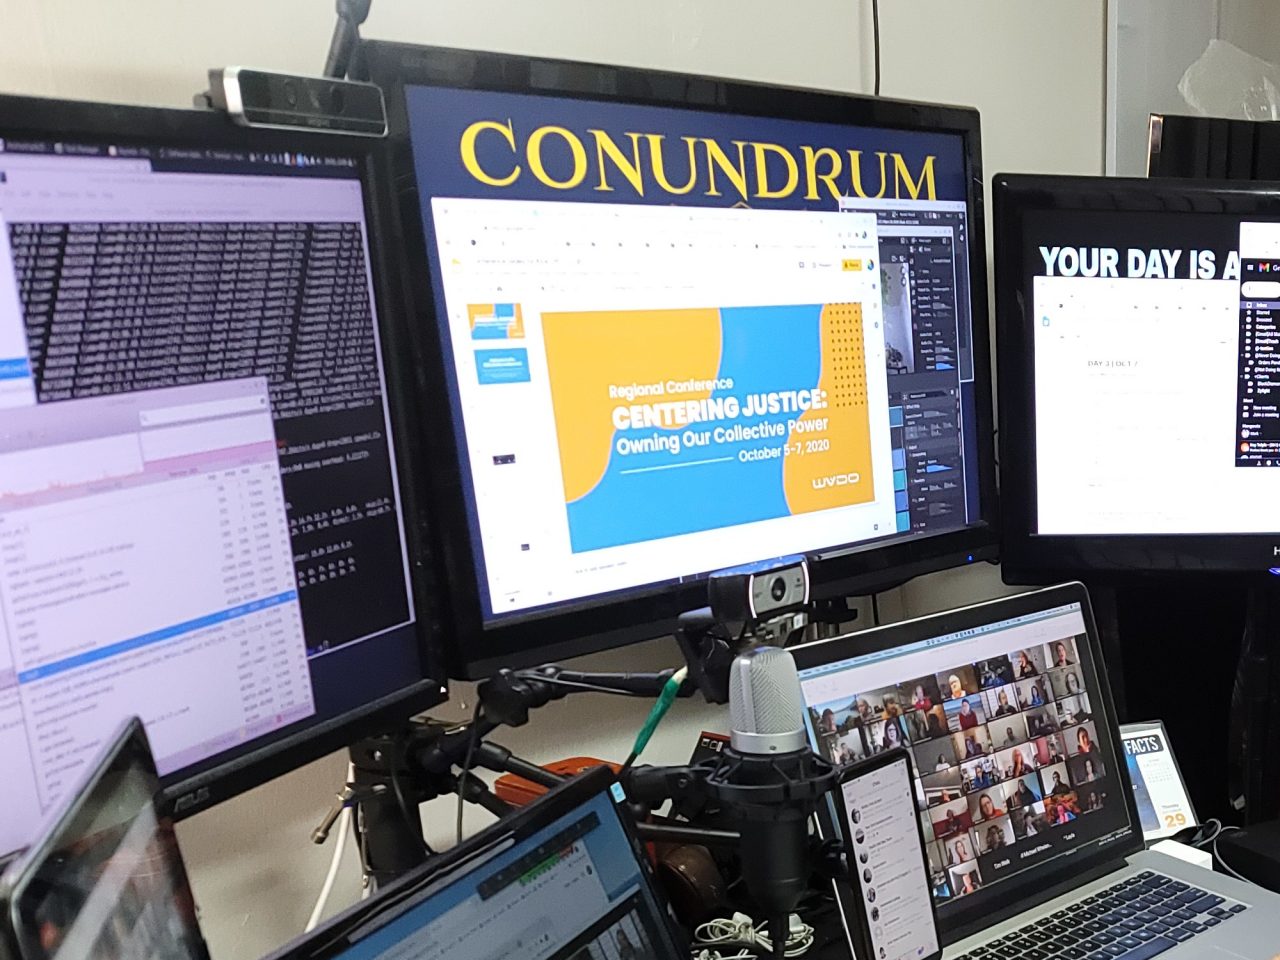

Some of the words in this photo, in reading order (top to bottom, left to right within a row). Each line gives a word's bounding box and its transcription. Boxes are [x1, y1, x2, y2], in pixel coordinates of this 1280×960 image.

[460, 118, 937, 201] CONUNDRUM
[1039, 247, 1120, 277] YOUR
[1127, 249, 1182, 278] DAY
[1190, 250, 1216, 279] IS
[609, 382, 664, 401] Regional
[666, 378, 734, 394] Conference
[612, 397, 740, 430] CENTERING
[741, 388, 828, 417] JUSTICE:
[617, 432, 680, 455] Owning
[683, 430, 711, 447] Our
[714, 420, 785, 443] Collective
[788, 418, 829, 435] Power
[738, 446, 781, 462] October
[783, 442, 805, 456] 5-7,
[806, 439, 829, 453] 2020
[1124, 736, 1159, 755] FACTS
[1165, 813, 1186, 828] 29
